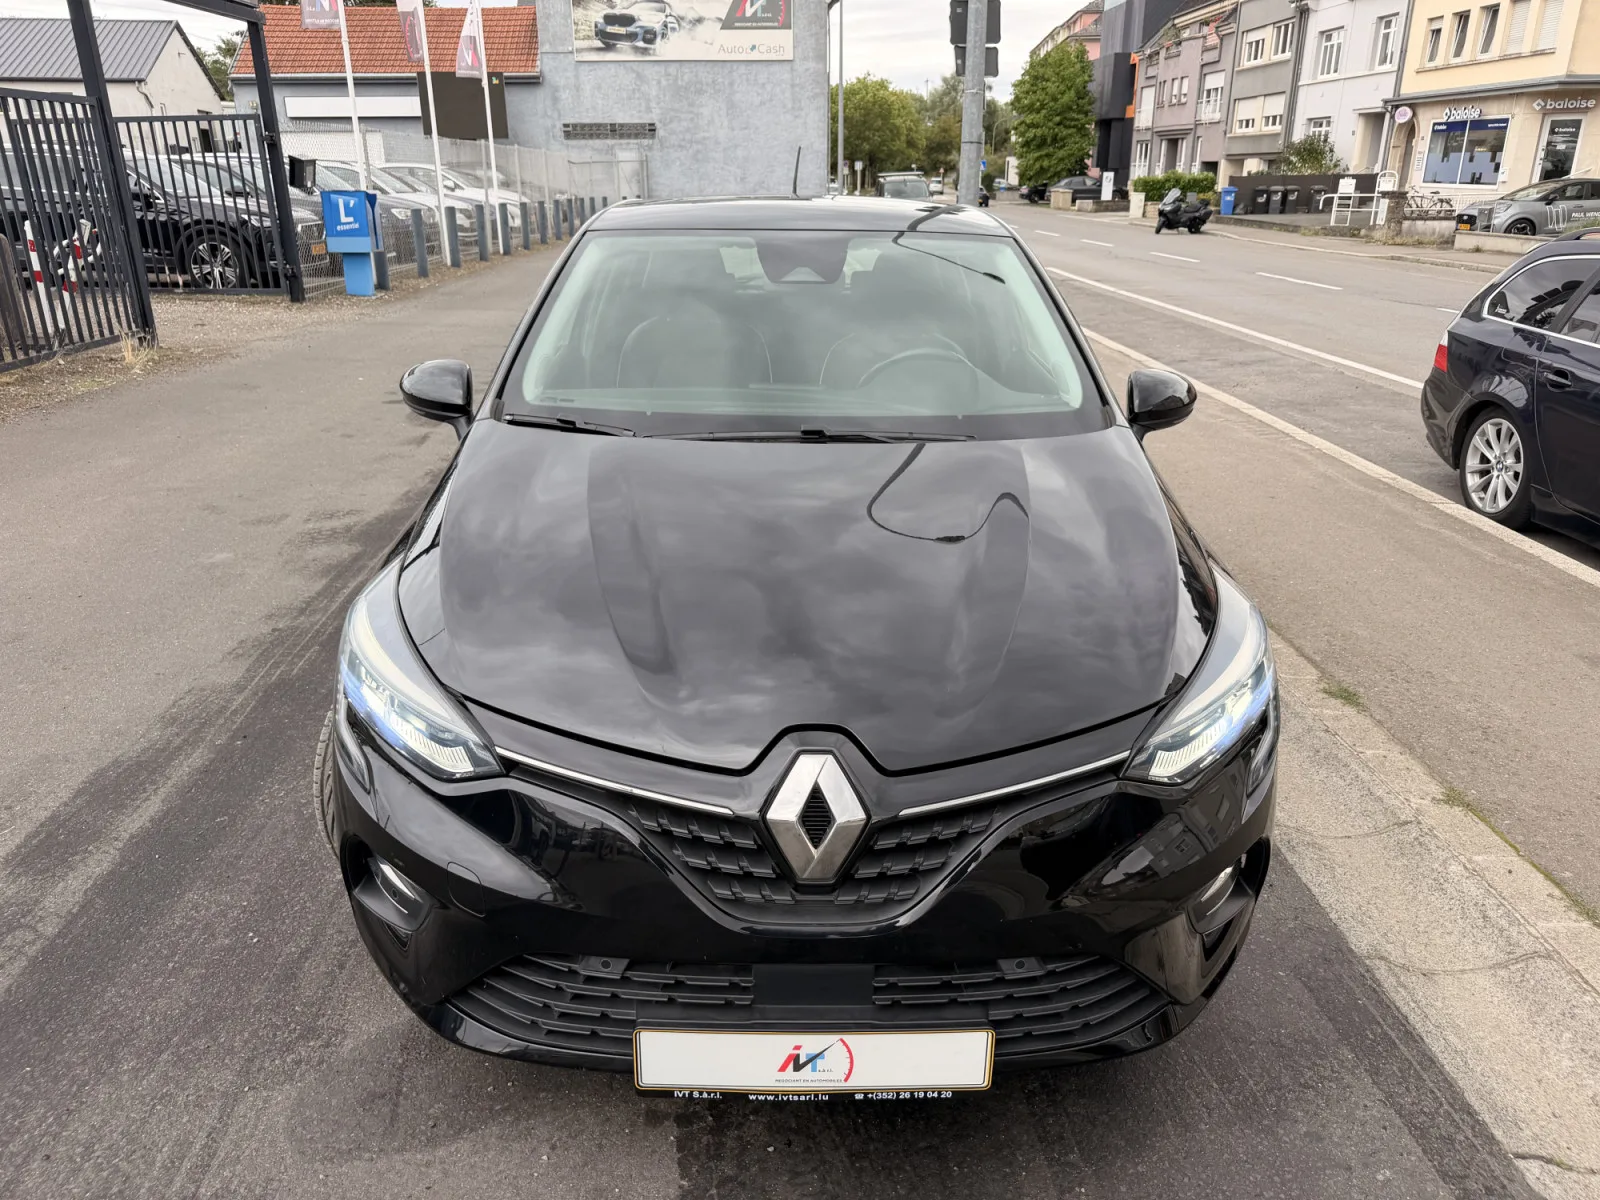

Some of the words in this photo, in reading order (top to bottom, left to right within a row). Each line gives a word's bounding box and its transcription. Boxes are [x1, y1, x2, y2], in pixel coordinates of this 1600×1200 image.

[758, 44, 785, 54] Cash
[1546, 97, 1596, 109] baloise
[1450, 105, 1481, 119] baloise
[673, 1090, 690, 1098] IVT
[748, 1093, 829, 1101] www.ivtsarl.lu
[867, 1092, 897, 1100] +(352)
[899, 1091, 911, 1099] 26
[914, 1091, 925, 1099] 19
[940, 1090, 953, 1098] 20
